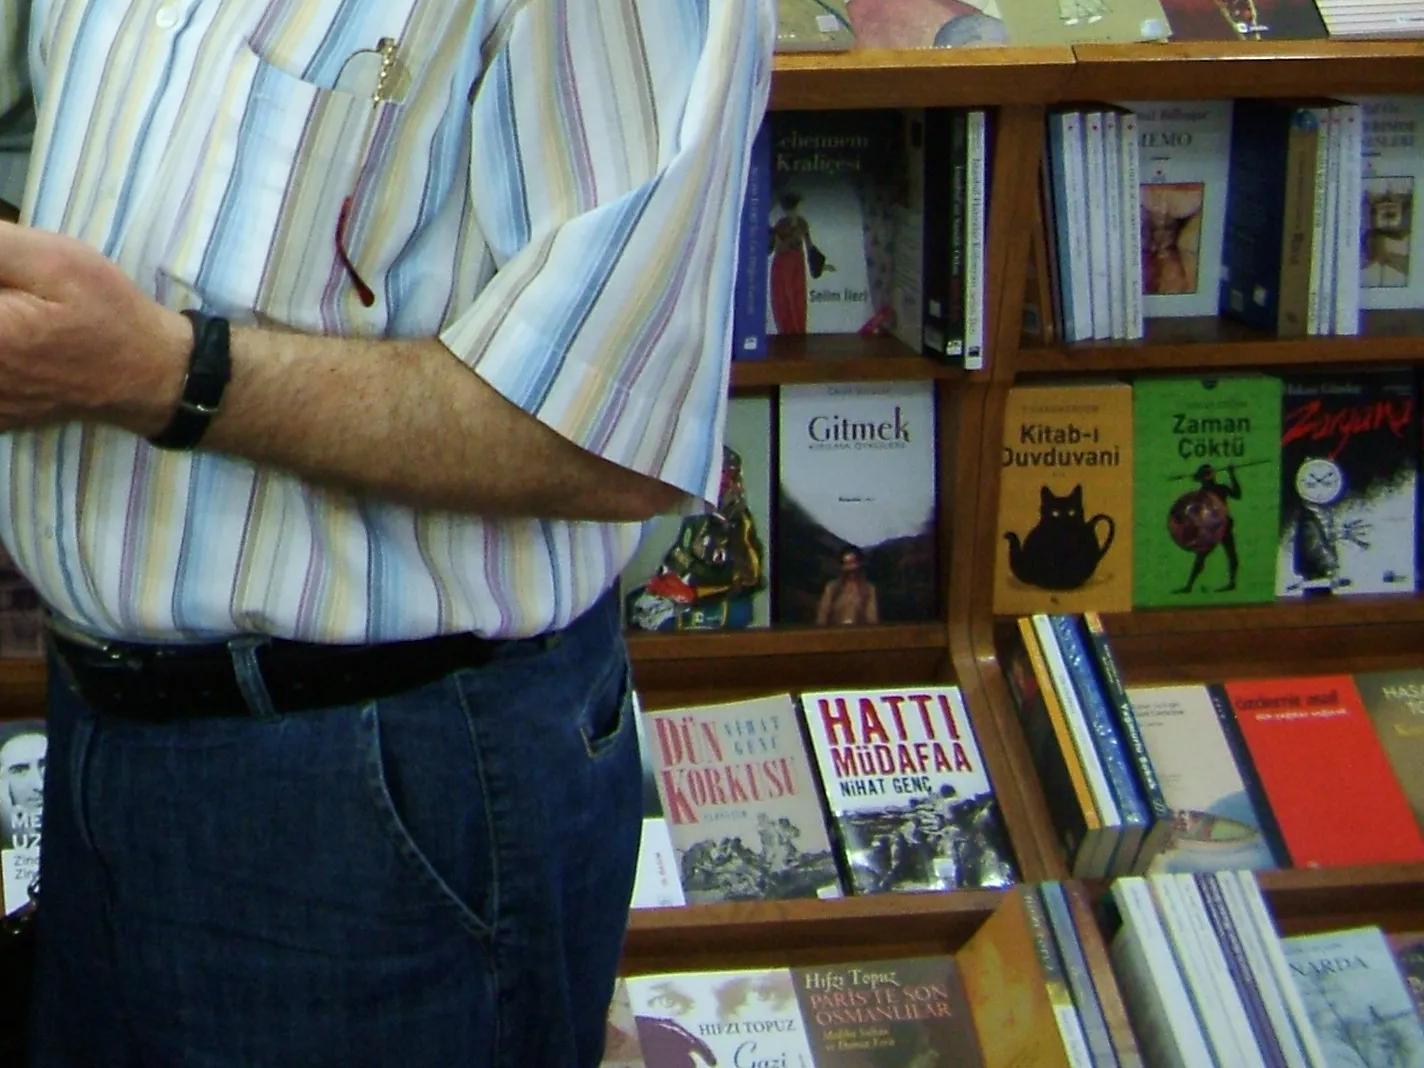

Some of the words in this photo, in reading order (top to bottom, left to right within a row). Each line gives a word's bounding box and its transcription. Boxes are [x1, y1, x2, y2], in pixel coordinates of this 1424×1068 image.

[809, 288, 842, 302] Selim
[807, 405, 911, 444] Gitmek
[1020, 422, 1100, 445] Kitab-ı
[1172, 413, 1251, 435] Zaman
[1178, 437, 1246, 461] Çöktü
[817, 694, 960, 745] HATTI
[654, 714, 726, 768] DÜN
[829, 743, 973, 778] MÜDAFAA
[662, 755, 798, 826] KORKUSU
[839, 778, 886, 798] NİHAT
[892, 775, 933, 795] GENÇ
[805, 970, 845, 993] Hıfzı
[850, 967, 901, 988] Topuz
[902, 984, 949, 1003] SON
[815, 1003, 953, 1027] OSMANLILAR
[698, 1021, 742, 1037] HIFZI
[743, 1018, 798, 1035] TOPUZ
